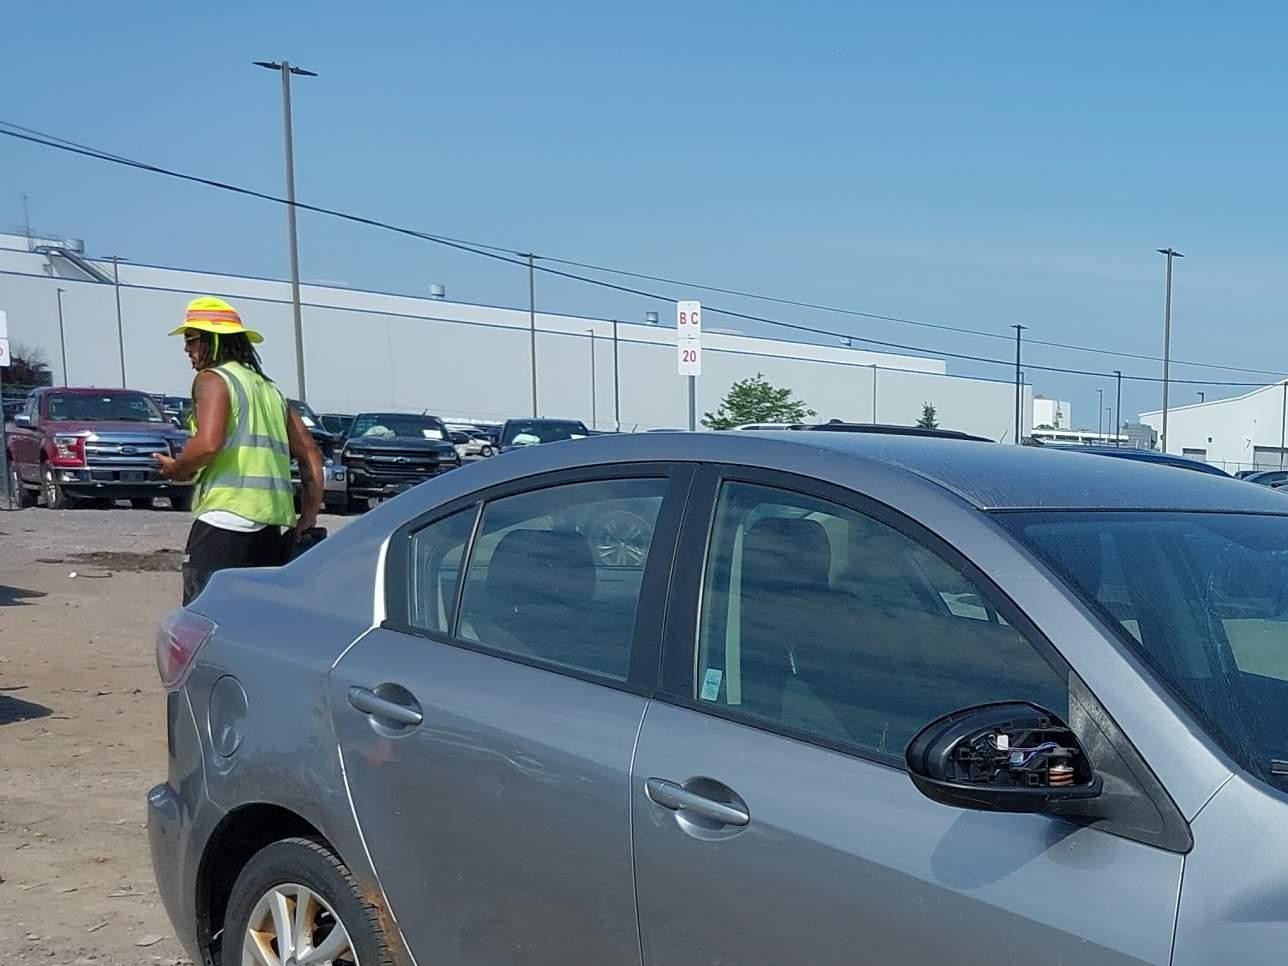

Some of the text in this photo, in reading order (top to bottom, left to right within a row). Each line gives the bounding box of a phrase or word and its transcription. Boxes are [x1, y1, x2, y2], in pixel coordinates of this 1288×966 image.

[680, 312, 698, 324] B C
[682, 350, 697, 362] 20
